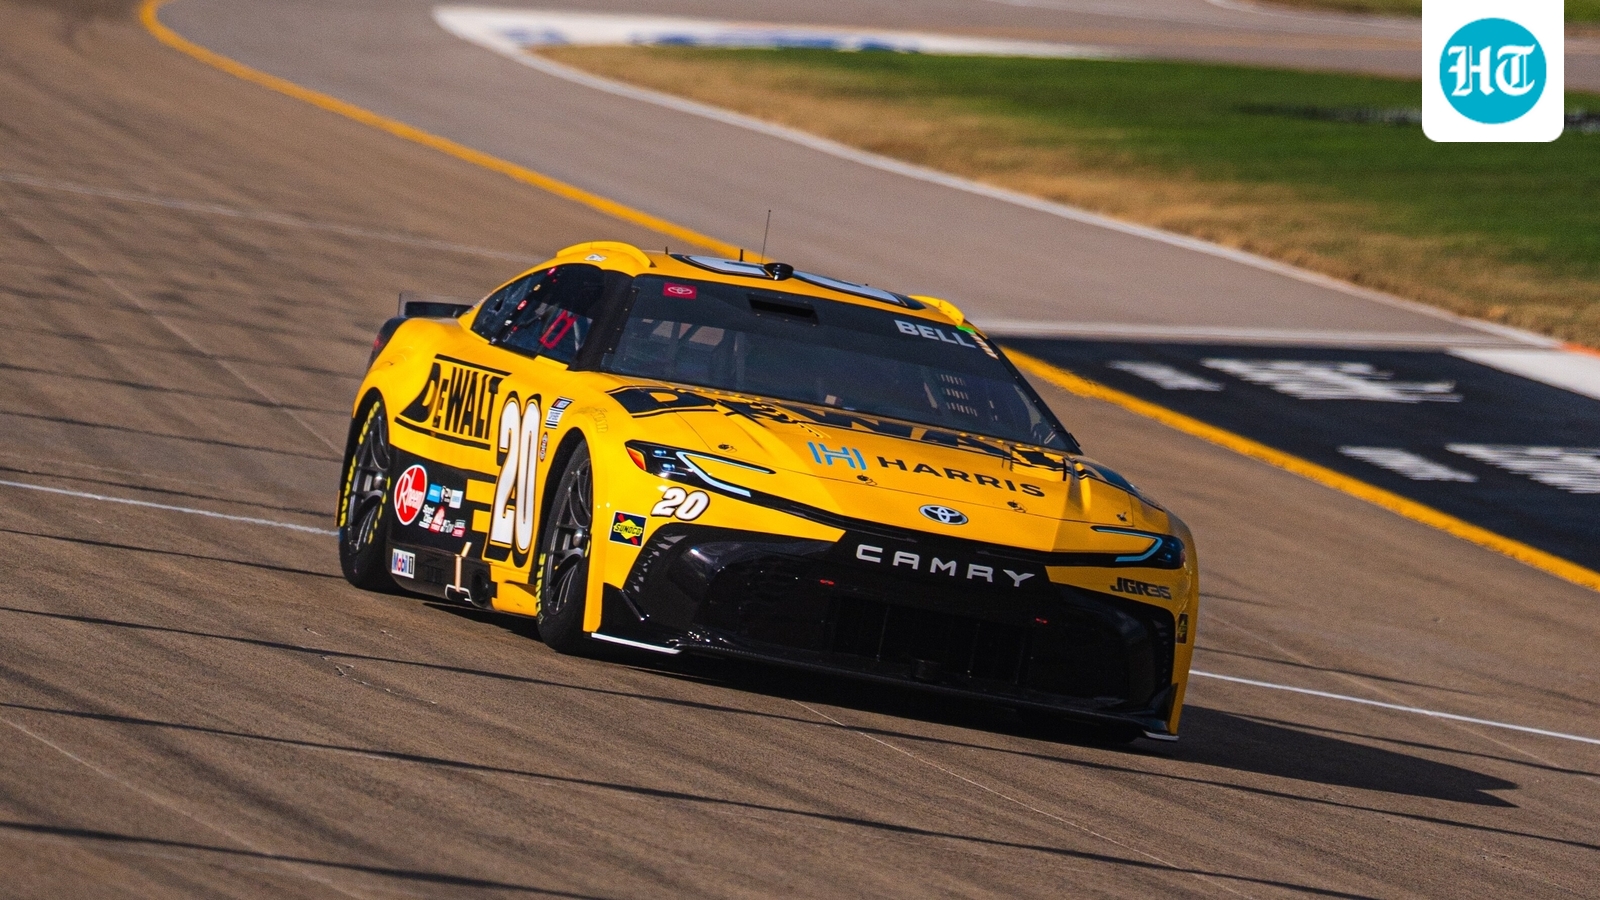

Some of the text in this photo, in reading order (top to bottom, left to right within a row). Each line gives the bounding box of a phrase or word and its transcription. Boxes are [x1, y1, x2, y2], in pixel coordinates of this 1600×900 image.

[893, 319, 977, 349] BELL
[488, 394, 542, 562] 20
[876, 455, 1046, 498] HARRIS
[651, 487, 710, 521] 20
[614, 524, 643, 536] SUNOCO
[855, 543, 1035, 589] CAMRY
